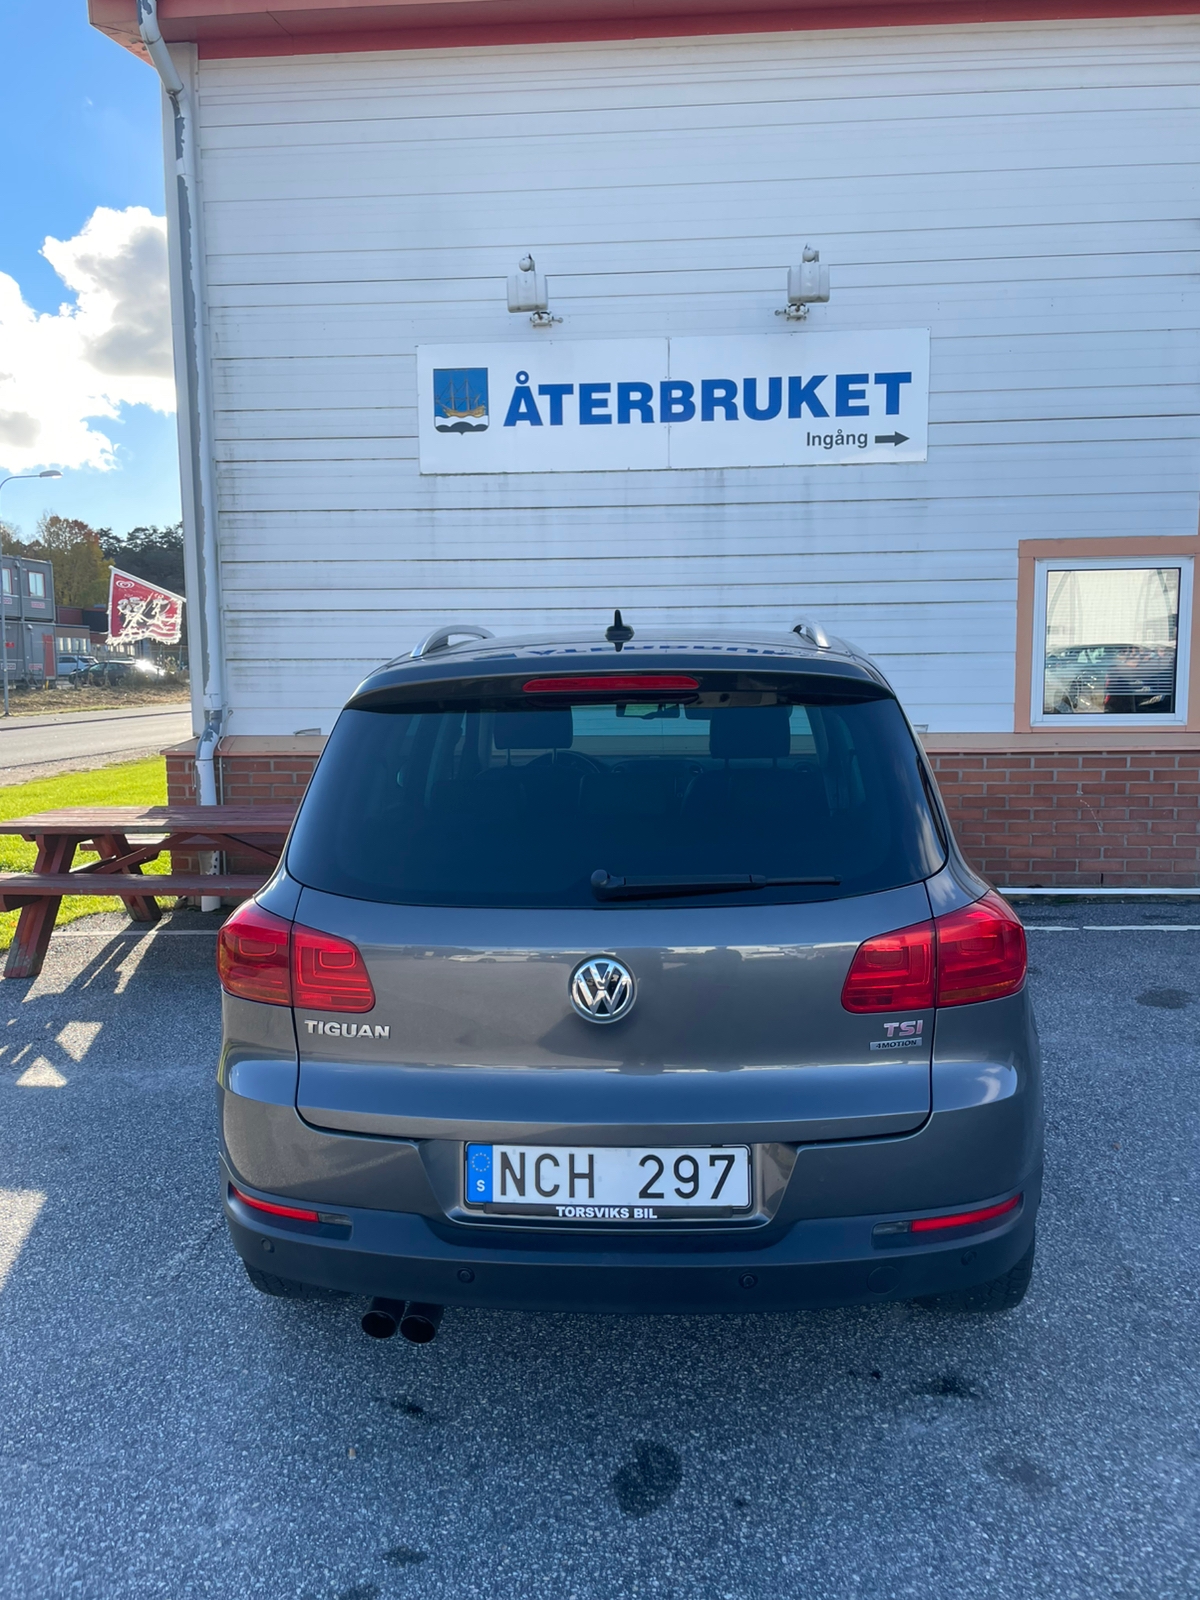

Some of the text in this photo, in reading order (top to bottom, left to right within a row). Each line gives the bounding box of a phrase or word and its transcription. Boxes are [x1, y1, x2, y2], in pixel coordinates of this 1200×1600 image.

[503, 371, 912, 427] ÅTERBRUKET
[806, 429, 868, 450] Ingång
[574, 958, 632, 1018] VW
[304, 1019, 391, 1039] TIGUAN
[883, 1019, 923, 1037] TSI
[875, 1040, 917, 1049] 4MOTION
[500, 1151, 735, 1200] NCH 297
[476, 1180, 486, 1192] S
[556, 1206, 657, 1219] TORSVIKS BIL
